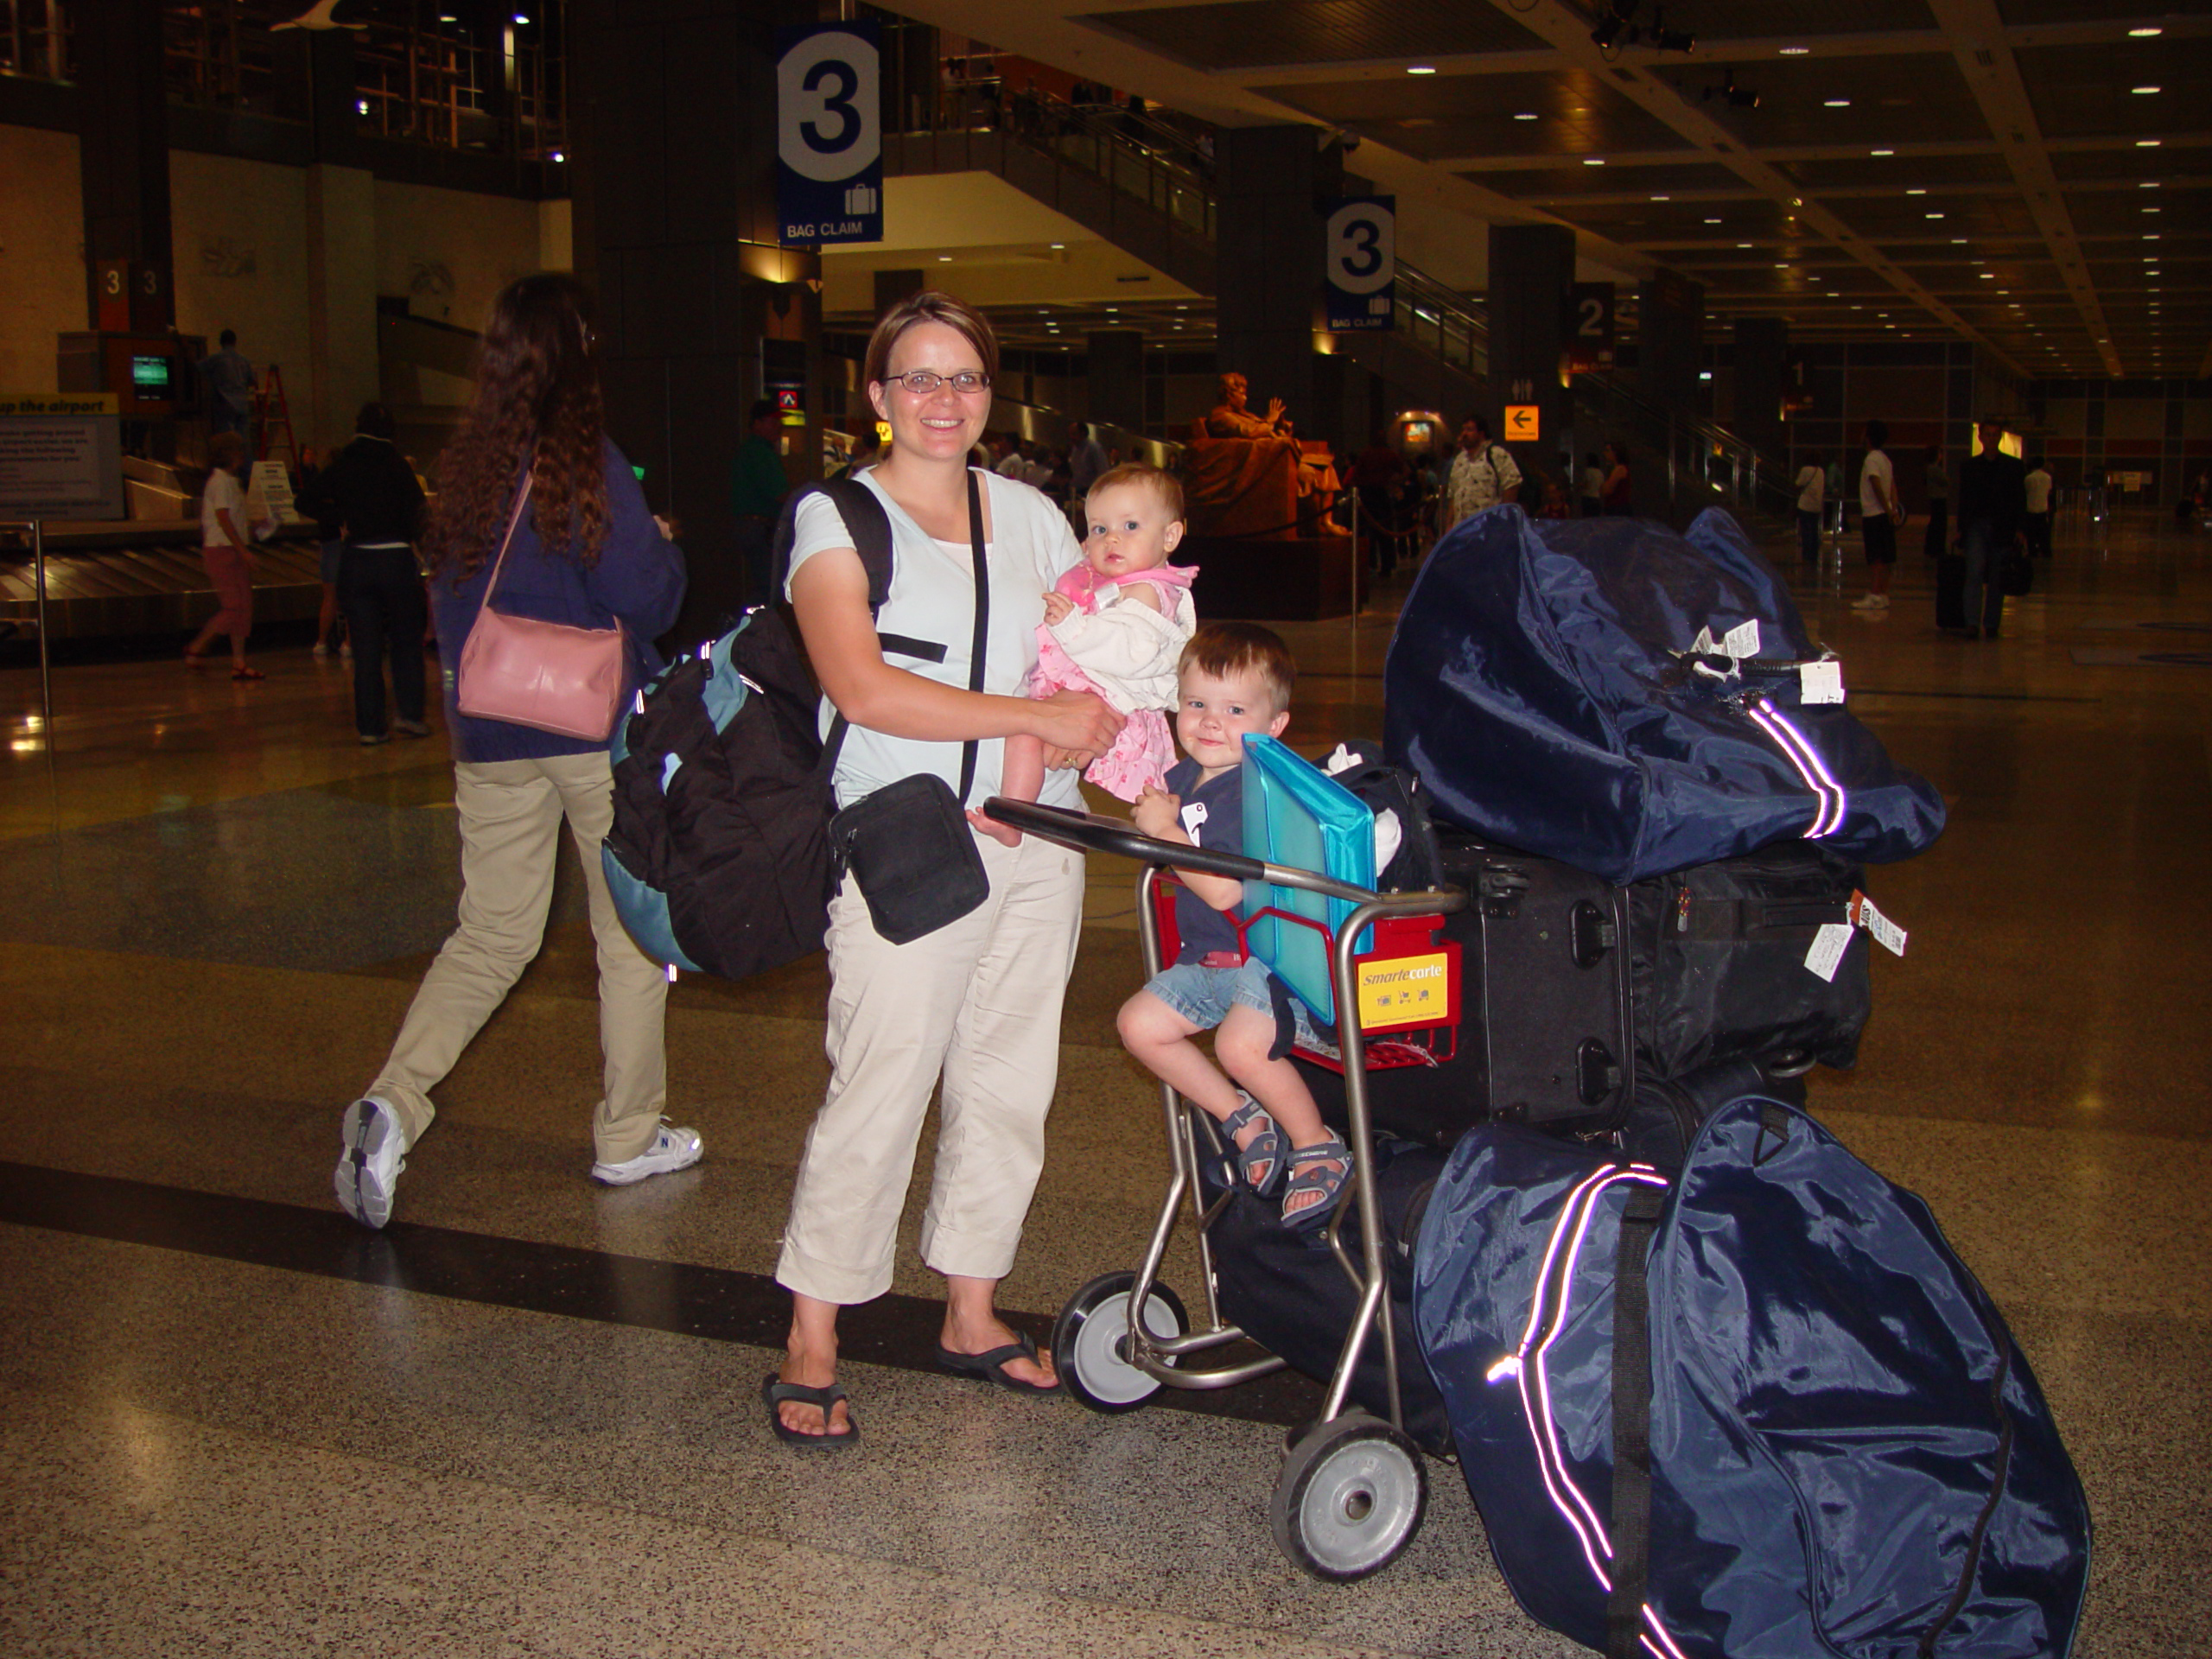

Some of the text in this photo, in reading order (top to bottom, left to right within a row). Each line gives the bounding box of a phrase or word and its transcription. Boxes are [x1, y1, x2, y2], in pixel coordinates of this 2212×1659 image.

[800, 60, 861, 154] 3
[787, 222, 862, 238] BAG CLAIM
[1342, 219, 1382, 276] 3
[106, 270, 119, 295] 3
[143, 270, 157, 295] 3
[1332, 317, 1382, 328] BAG CLAIM
[1578, 298, 1604, 336] 2
[1791, 360, 1804, 386] 1
[0, 399, 104, 415] up the airport
